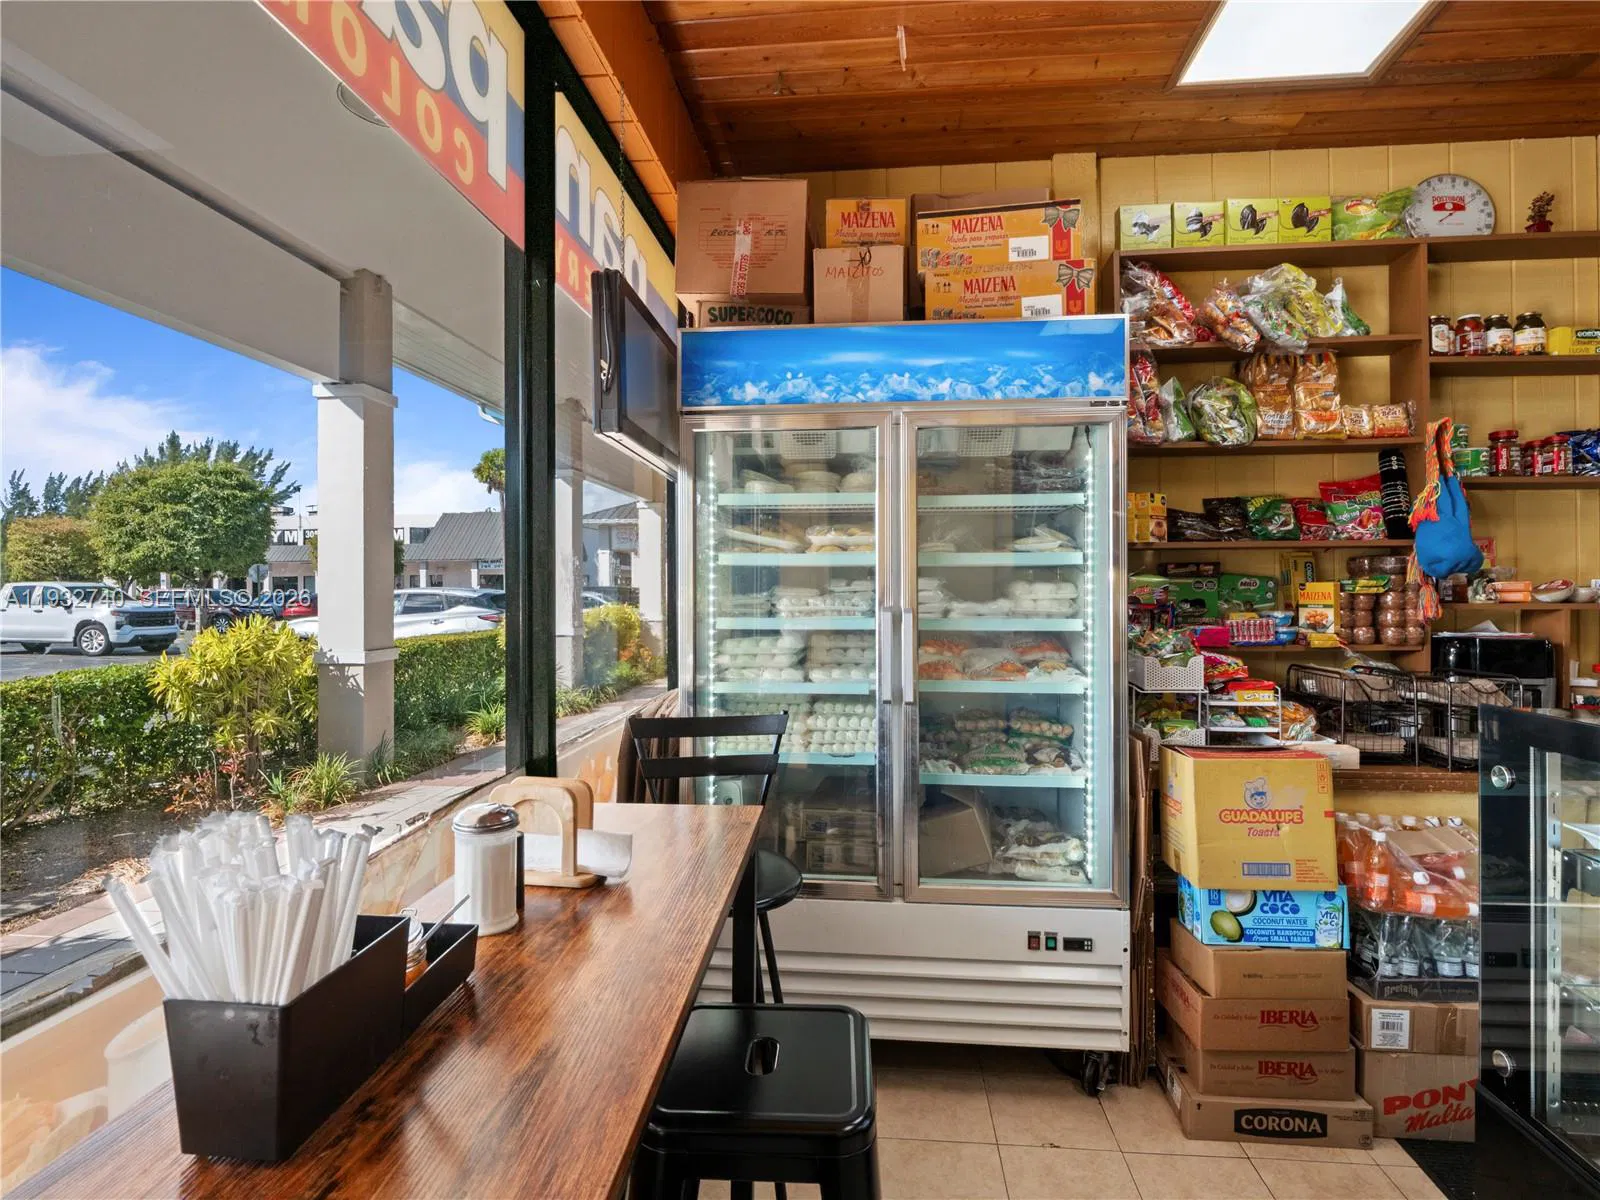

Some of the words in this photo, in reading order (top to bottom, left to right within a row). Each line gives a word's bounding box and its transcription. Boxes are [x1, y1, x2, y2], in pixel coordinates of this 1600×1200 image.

[840, 211, 896, 229] MAIZENA
[951, 215, 1004, 234] MAIZENA
[963, 275, 1017, 295] MAIZENA
[707, 306, 793, 325] SUPERCOCO
[1239, 580, 1259, 588] MILO
[1300, 591, 1332, 602] MAIZENA
[1219, 809, 1304, 825] GUADALUPE
[1262, 890, 1295, 902] VITA
[1260, 903, 1300, 914] COCO
[1252, 917, 1285, 925] COCONUT
[1259, 1010, 1319, 1027] IBERIA
[1257, 1060, 1318, 1078] IBERIA
[1240, 1113, 1323, 1134] CORONA
[1404, 1103, 1475, 1134] Malta
